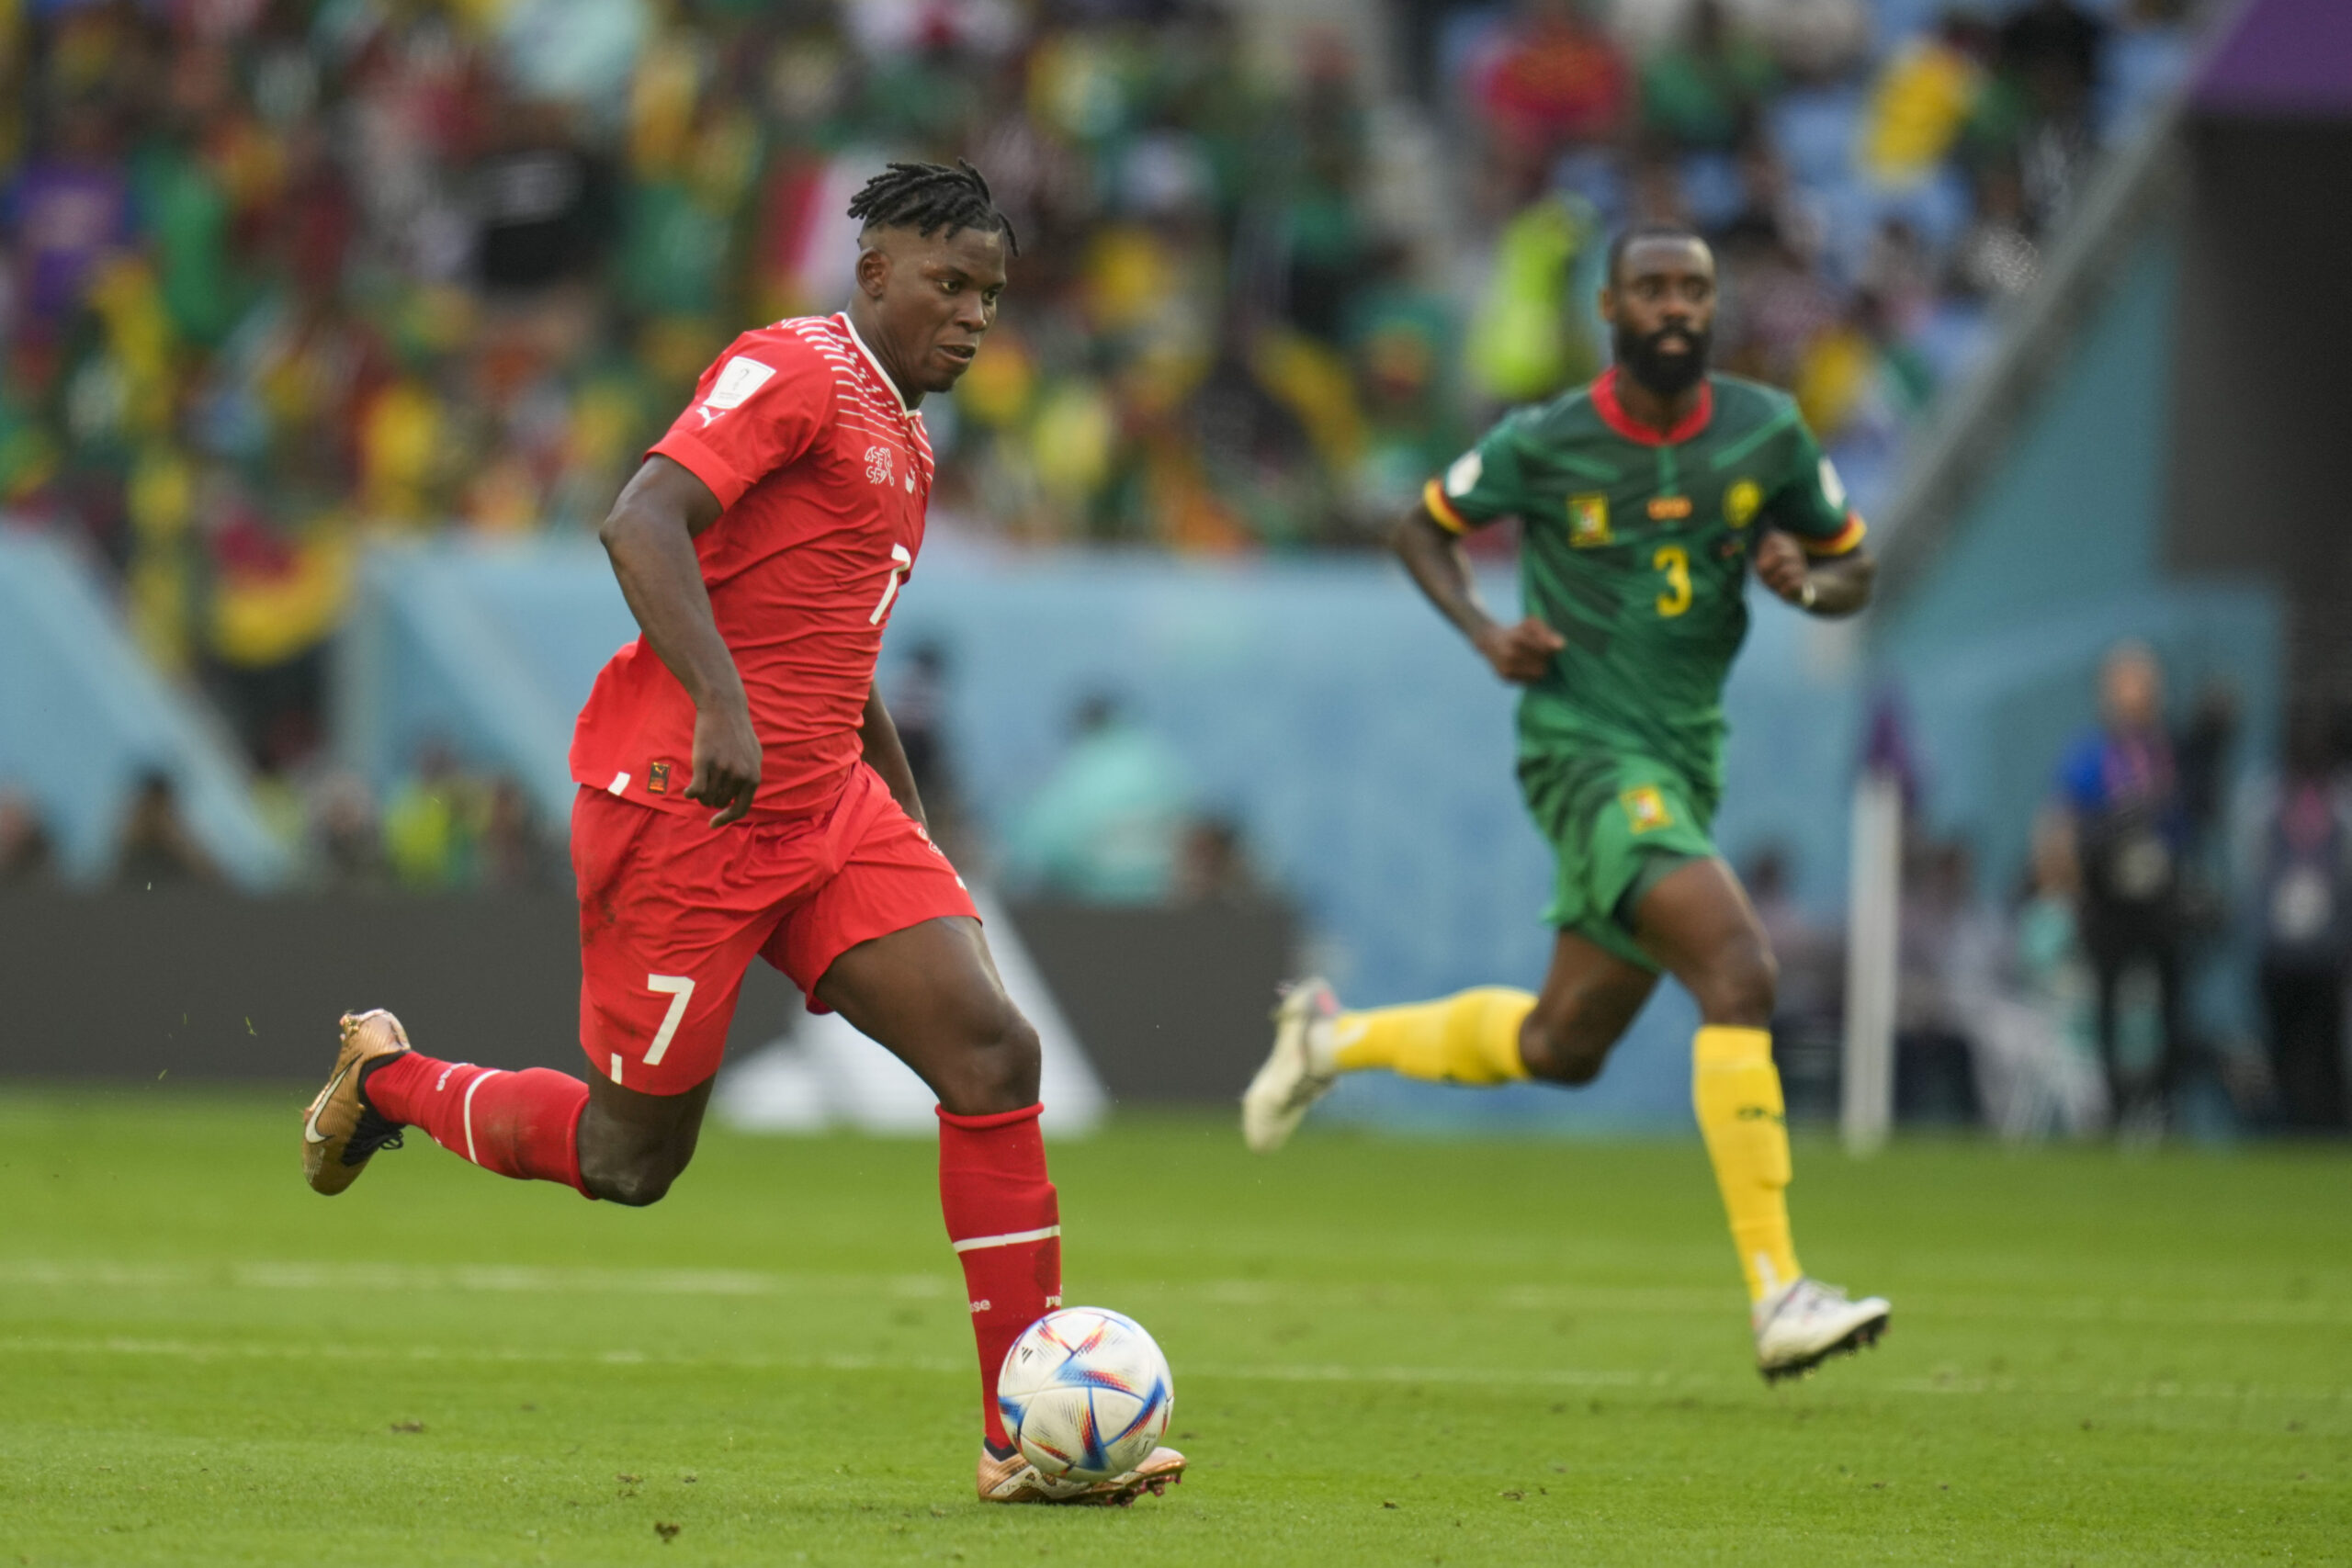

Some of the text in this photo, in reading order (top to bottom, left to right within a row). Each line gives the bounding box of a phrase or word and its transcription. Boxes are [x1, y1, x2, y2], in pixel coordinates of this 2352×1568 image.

[869, 543, 911, 626] 7
[1653, 546, 1693, 618] 3
[642, 973, 696, 1066] 7
